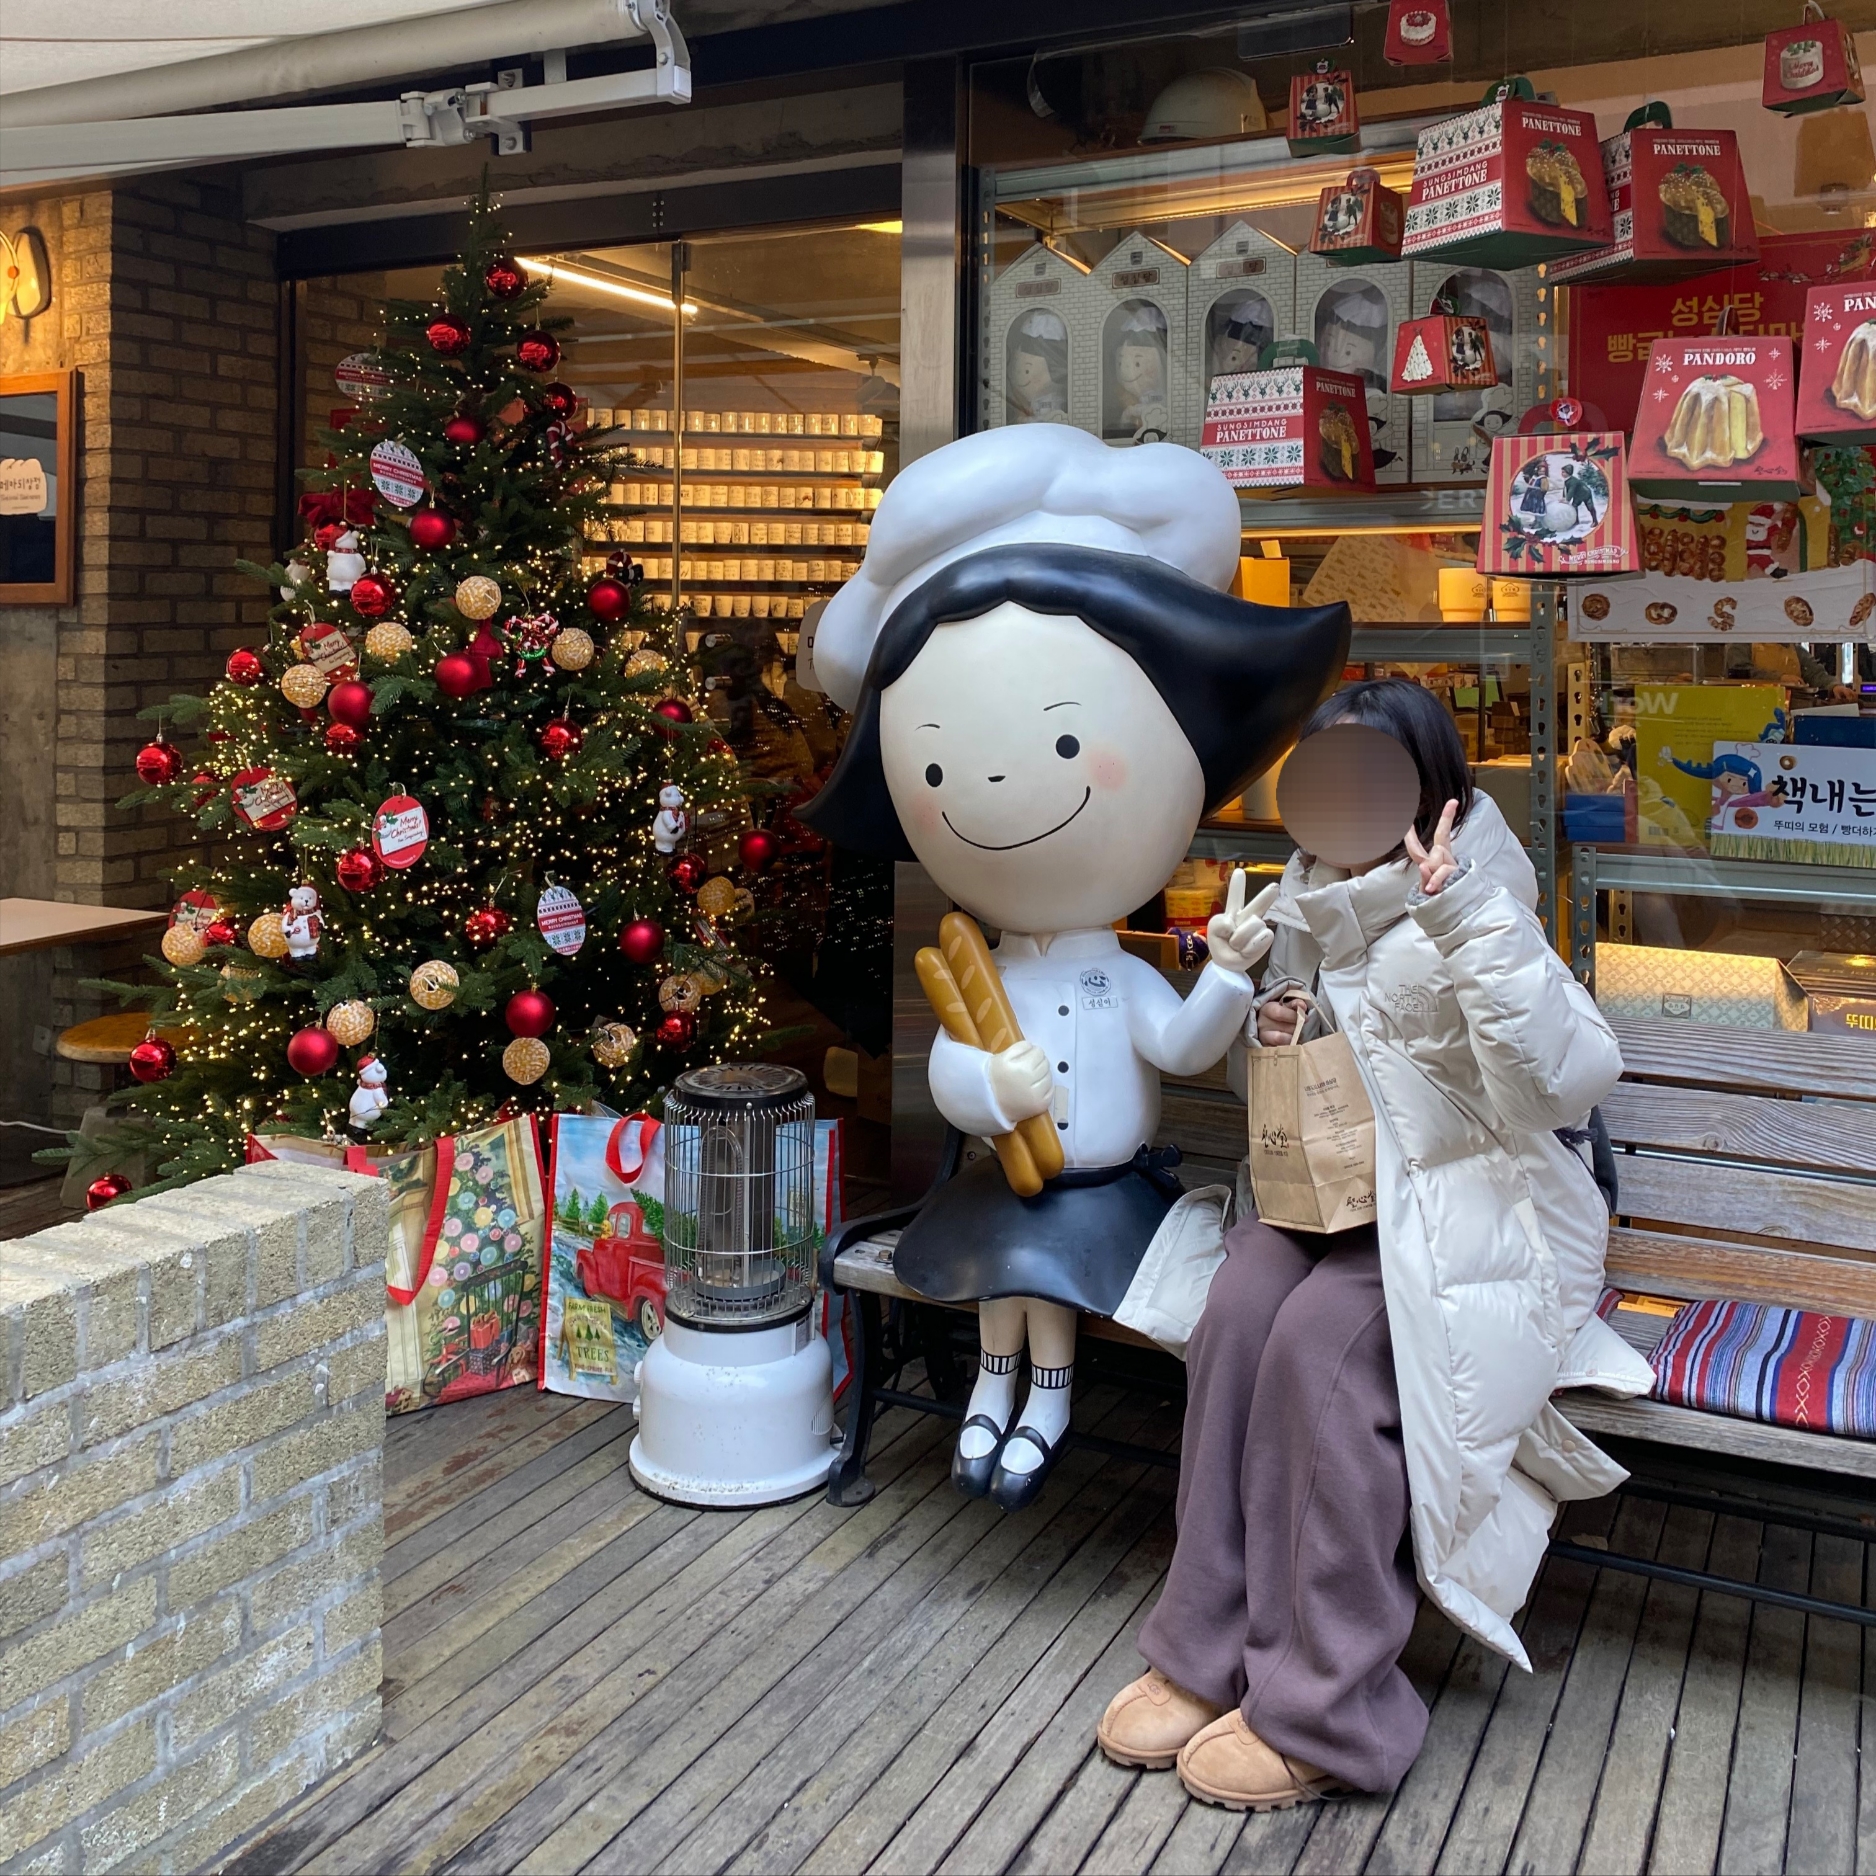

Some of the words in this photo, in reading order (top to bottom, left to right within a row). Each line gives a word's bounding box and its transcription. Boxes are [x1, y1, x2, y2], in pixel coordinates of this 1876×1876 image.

[1522, 117, 1582, 136] PANETTONE
[1653, 143, 1721, 156] PANETTONE
[1422, 161, 1488, 188] SUNGSIMDANG
[1421, 169, 1488, 201] PANETTONE
[1671, 291, 1765, 327] 성심당
[1844, 296, 1876, 312] PAN
[1682, 351, 1757, 366] PANDORO
[1316, 381, 1356, 398] PANETTONE
[1216, 419, 1288, 431] SUNGSIMDANG
[1216, 426, 1287, 443] PANETTONE
[1771, 774, 1876, 817] 책내는
[400, 815, 418, 827] Merry
[1773, 820, 1804, 831] 뚜띠의
[1808, 822, 1829, 834] 모험
[1398, 984, 1419, 994] THE
[1384, 992, 1417, 1003] NORTH
[1394, 1002, 1419, 1013] FACE
[1846, 1013, 1876, 1031] 뚜띠
[575, 1346, 609, 1363] TREES
